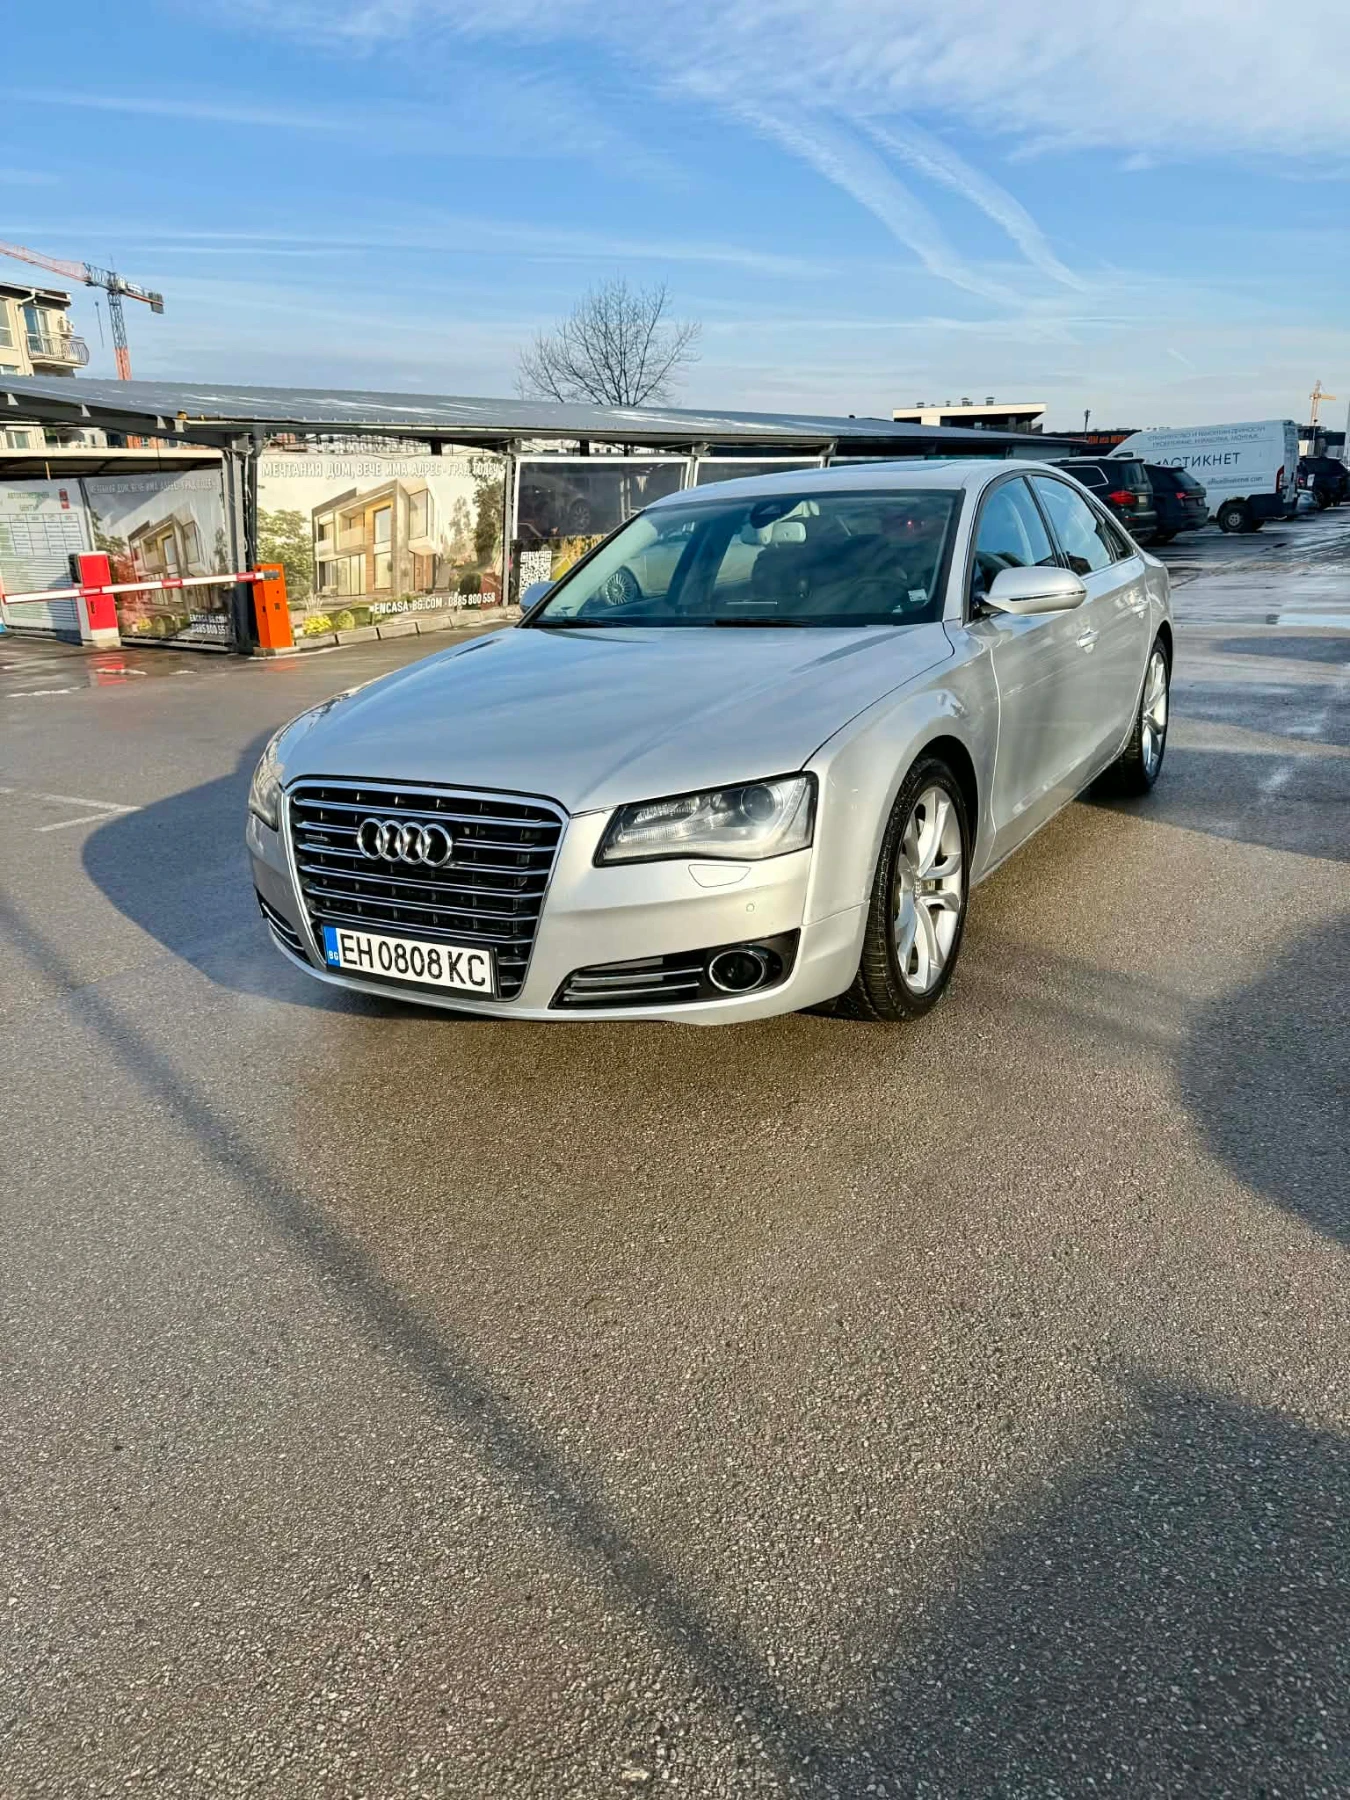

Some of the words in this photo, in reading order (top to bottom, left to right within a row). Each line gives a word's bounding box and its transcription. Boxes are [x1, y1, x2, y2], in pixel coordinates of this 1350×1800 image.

[262, 461, 323, 478] МЕЧТАНИЯ
[327, 462, 356, 478] ДОМ,
[356, 462, 382, 477] ВЕЧЕ
[386, 462, 409, 477] ИМА
[482, 591, 496, 603] 558
